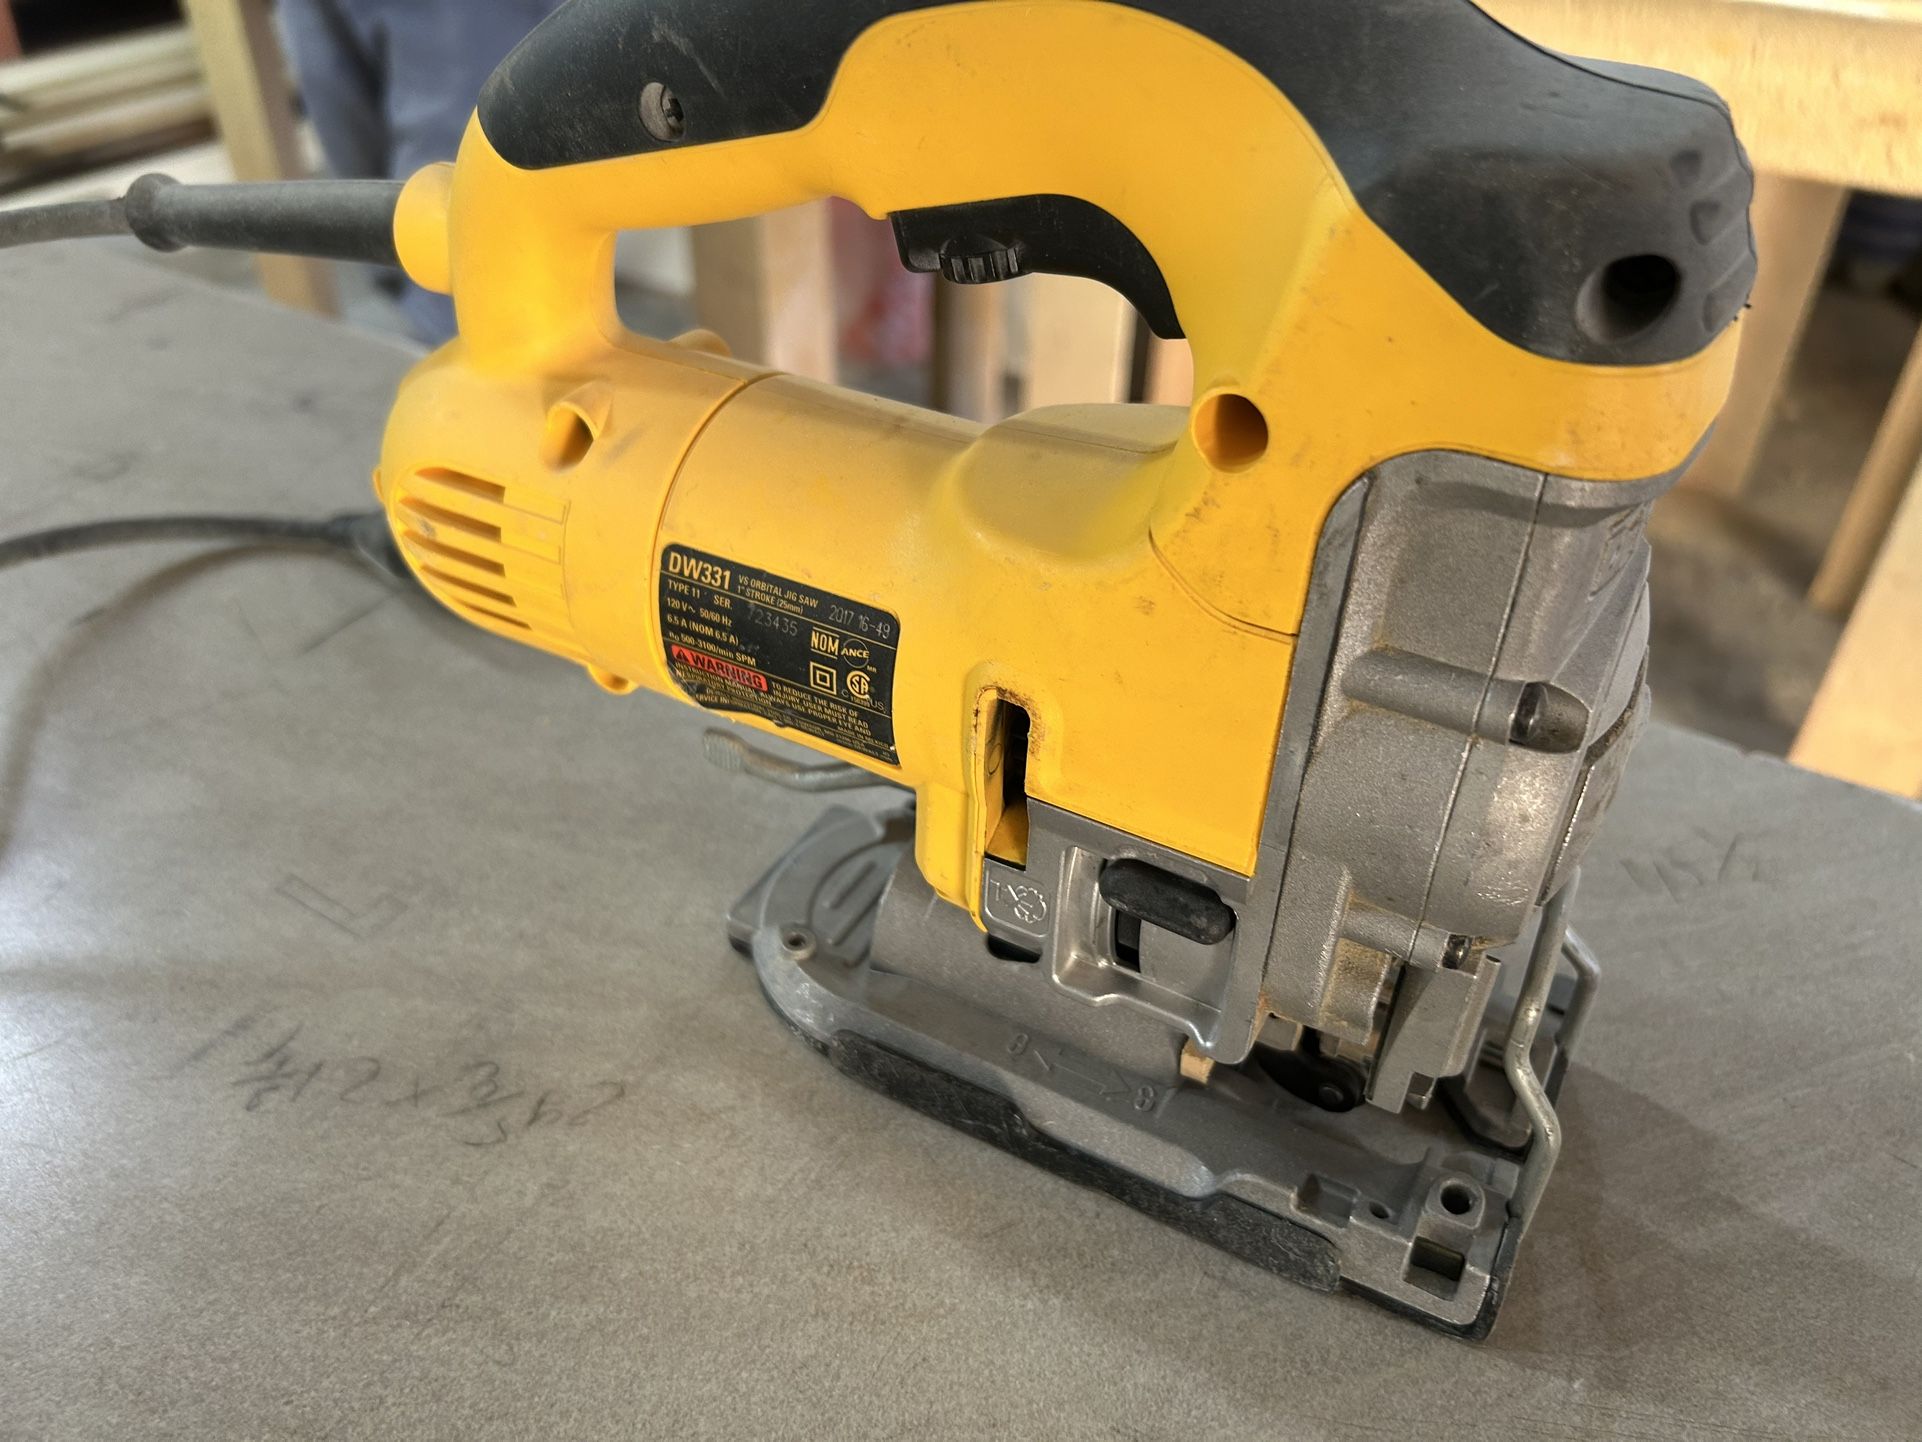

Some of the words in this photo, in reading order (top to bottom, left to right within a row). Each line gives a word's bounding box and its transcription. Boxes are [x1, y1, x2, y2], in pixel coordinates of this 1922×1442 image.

[669, 551, 731, 590] DW331
[668, 578, 690, 596] TYPE
[691, 587, 700, 599] 11
[713, 594, 733, 610] SER.
[738, 575, 749, 586] VS
[750, 579, 783, 598] ORBITAL
[784, 590, 797, 601] JIG
[799, 594, 819, 609] SAW
[745, 588, 776, 606] STROKE
[777, 598, 804, 616] (25mm)
[667, 597, 680, 609] 120
[700, 607, 721, 622] 50/60
[722, 615, 732, 628] Hz
[829, 604, 854, 626] 2017
[859, 613, 891, 640] 16-49
[667, 614, 680, 625] 6.5
[681, 618, 688, 629] A
[690, 621, 714, 637] (NOM
[715, 630, 728, 642] 6.5
[729, 635, 739, 646] A)
[811, 630, 839, 657] NOM
[681, 633, 734, 660] 500-3100/min
[736, 652, 757, 668] SPM
[841, 647, 870, 659] ANCE
[690, 652, 763, 689] WARNING
[771, 681, 781, 691] TO
[783, 685, 811, 701] REDUCE
[814, 695, 827, 707] THE
[830, 702, 848, 715] RISK
